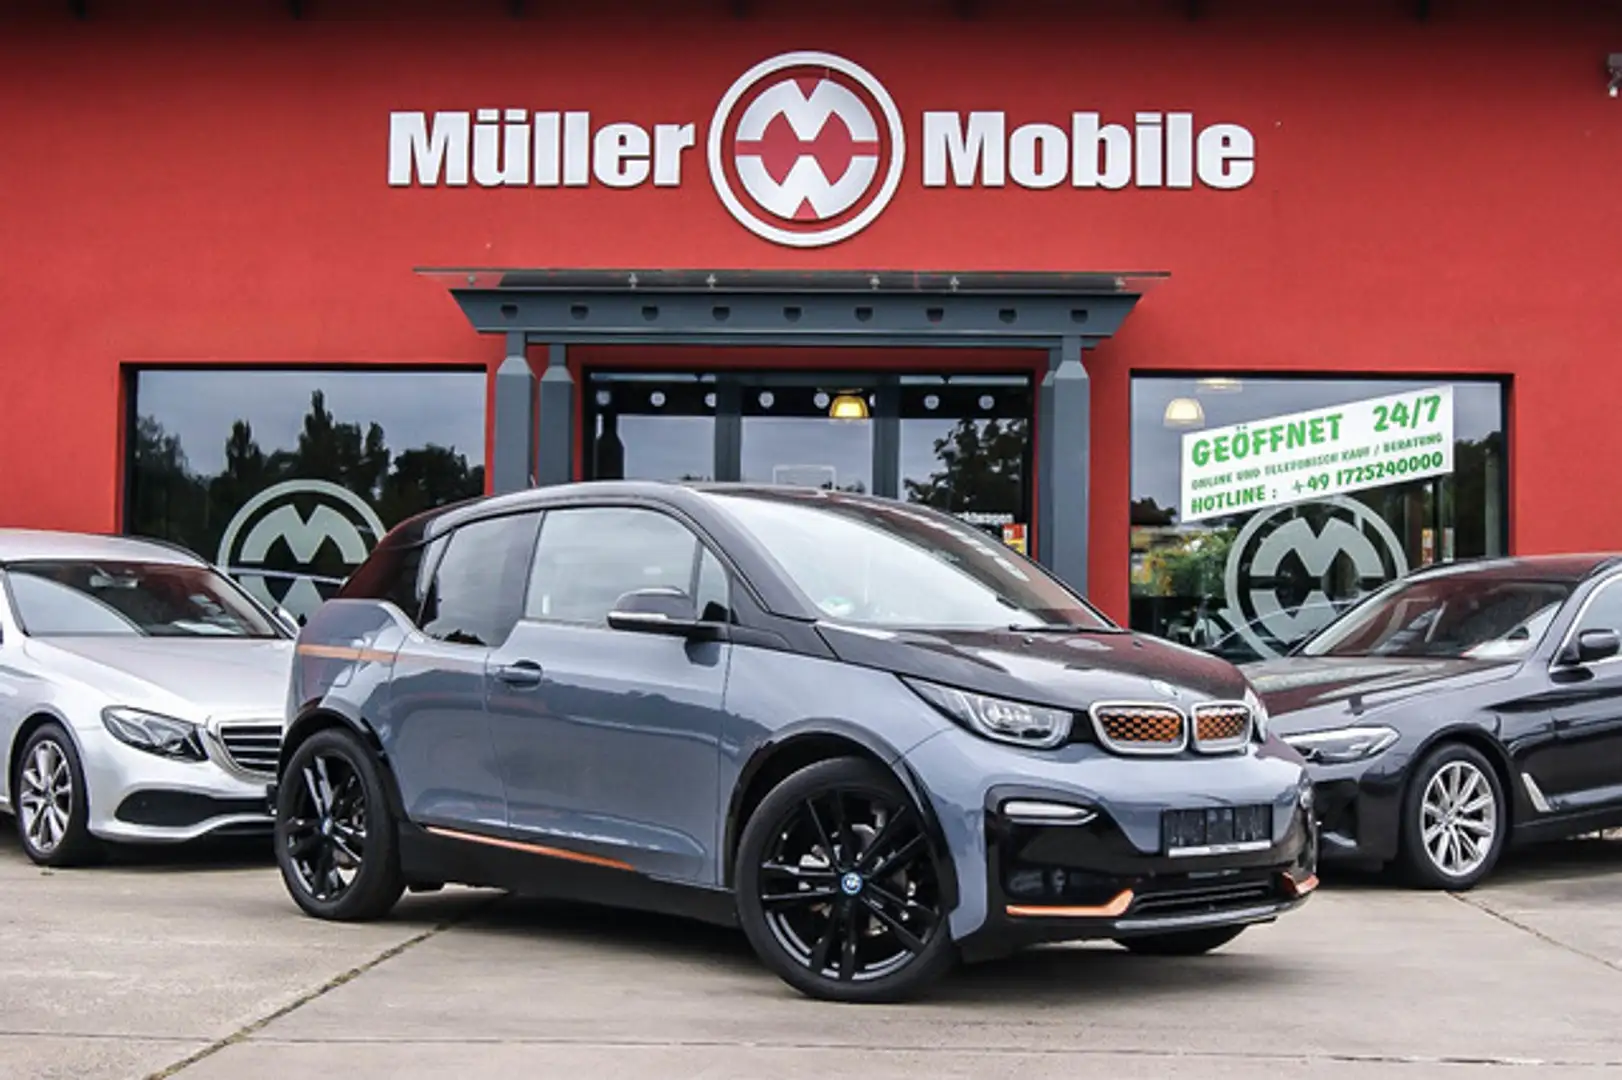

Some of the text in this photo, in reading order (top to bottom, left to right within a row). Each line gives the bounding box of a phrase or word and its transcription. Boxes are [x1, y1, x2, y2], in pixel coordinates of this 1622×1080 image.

[388, 108, 1256, 189] Müller Mobile
[1191, 472, 1232, 490] ONLINE
[1236, 468, 1260, 481] UND
[1383, 432, 1443, 453] BERATUNG
[1192, 395, 1441, 467] GEÖFFNET 24/7
[1191, 484, 1265, 514] HOTLINE
[1293, 473, 1329, 493] +49
[1336, 451, 1443, 486] 1725240000
